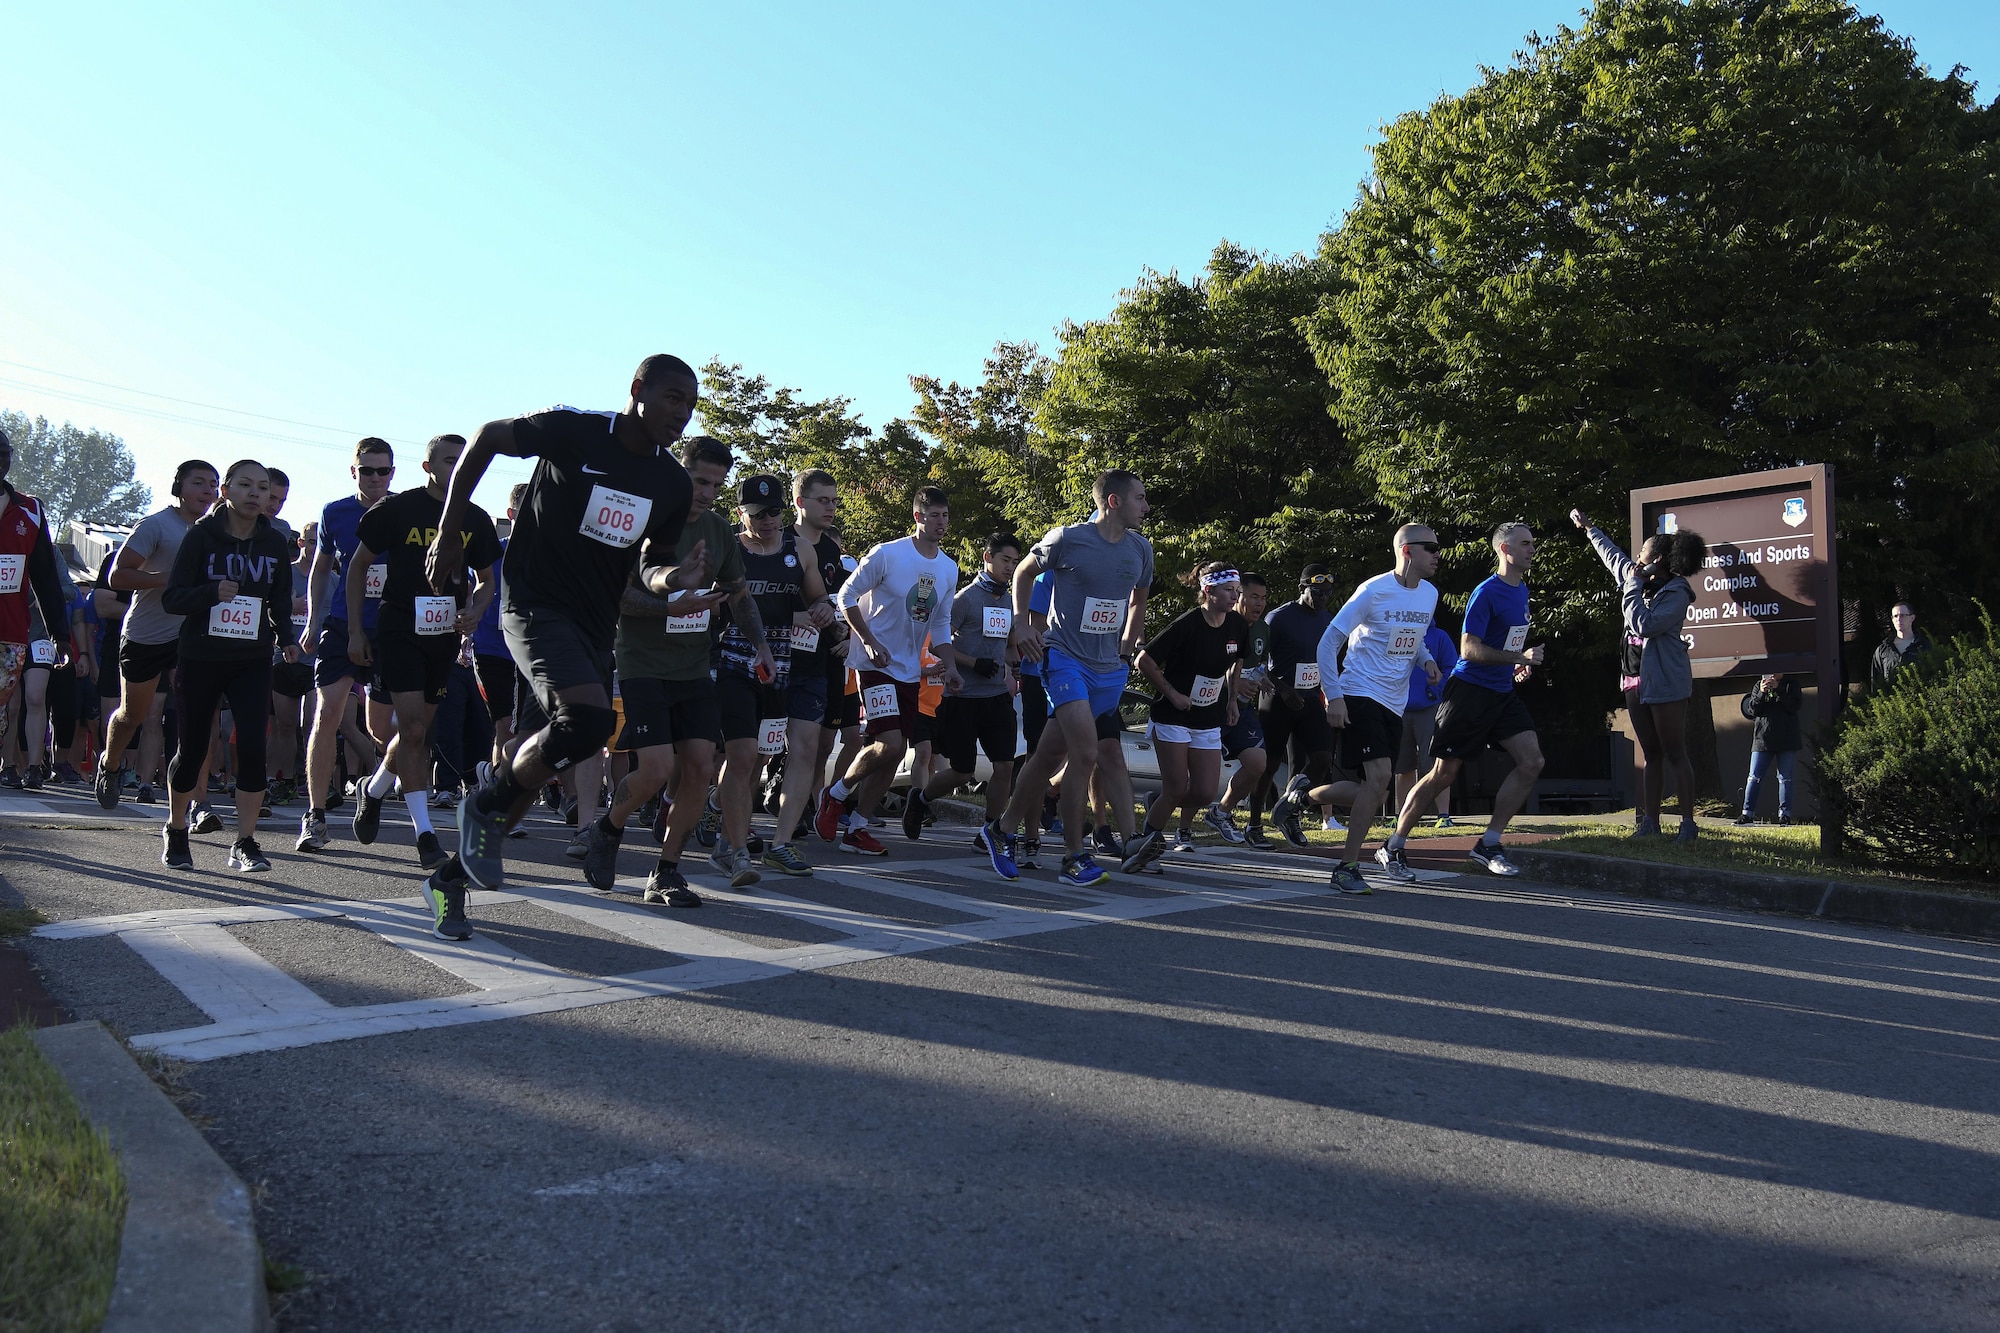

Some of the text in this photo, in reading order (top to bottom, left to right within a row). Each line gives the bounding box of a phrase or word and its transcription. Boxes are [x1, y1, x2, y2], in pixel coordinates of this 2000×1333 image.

[597, 506, 634, 532] 008
[405, 527, 473, 549] ARY
[605, 532, 618, 542] AIR
[1701, 544, 1810, 568] ness And Sports
[1, 568, 17, 581] 57
[207, 553, 278, 584] LOVE
[366, 576, 381, 588] 46
[1704, 573, 1757, 592] Complex
[221, 608, 252, 625] 045
[425, 609, 449, 623] 061
[1091, 610, 1117, 624] 052
[1686, 601, 1779, 623] Open 24 Hours
[990, 617, 1006, 629] 093
[1395, 637, 1415, 648] 013
[1302, 671, 1318, 682] 062
[871, 694, 892, 708] 047
[767, 730, 784, 744] 05
